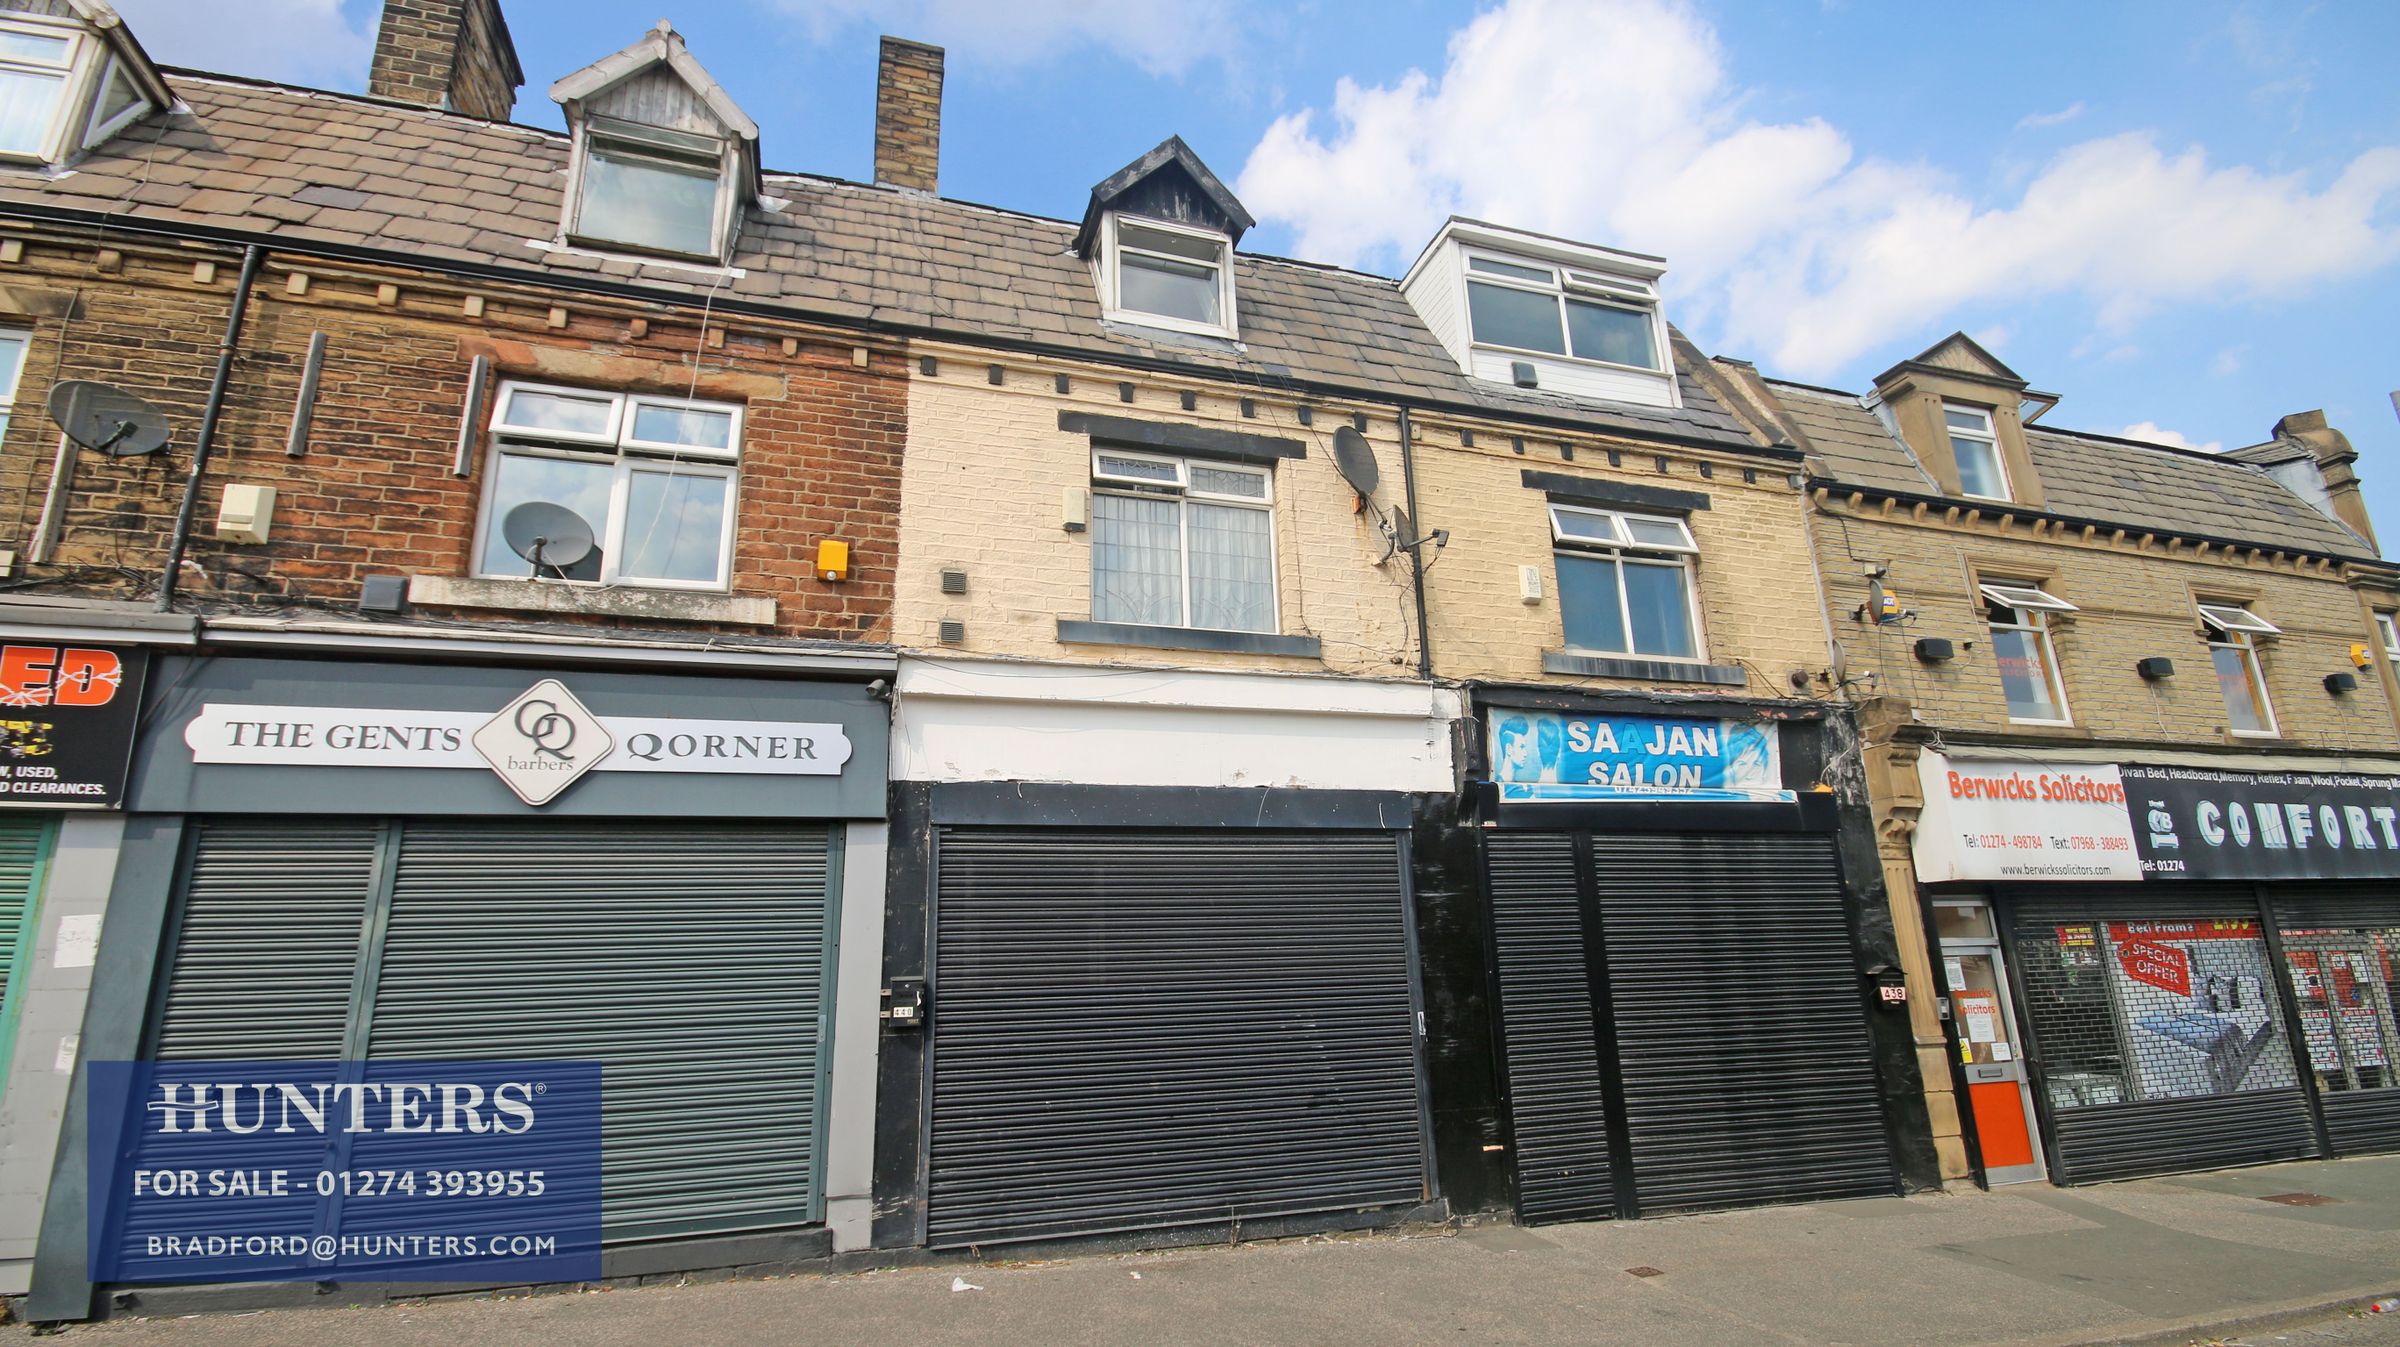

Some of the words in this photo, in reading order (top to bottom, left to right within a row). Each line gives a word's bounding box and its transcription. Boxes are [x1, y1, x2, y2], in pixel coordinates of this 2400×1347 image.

[225, 721, 314, 748] THE
[325, 724, 462, 752] GENTS
[1567, 720, 1719, 757] SAAJAN
[627, 733, 818, 762] QORNER
[16, 766, 59, 780] USED,
[508, 755, 574, 771] barbers
[1587, 761, 1702, 788] SALON
[12, 782, 107, 795] CLEARANCES.
[1947, 771, 2037, 799] Berwicks
[2039, 773, 2125, 803] Solicitors
[2196, 799, 2399, 850] COMFORT
[1963, 834, 1980, 849] Tel:
[1980, 834, 2006, 849] 01274
[2013, 835, 2043, 849] 498784
[2050, 836, 2071, 850] Text:
[2071, 836, 2095, 850] 07968
[2100, 836, 2129, 851] 388493
[2000, 863, 2112, 876] www.berwickssolicitors.com
[2139, 860, 2156, 871] Tel:
[2157, 860, 2185, 872] 01274
[2132, 943, 2183, 967] SPECIAL
[2136, 960, 2180, 984] OFFER
[1884, 988, 1903, 999] 438
[894, 1008, 912, 1016] 440
